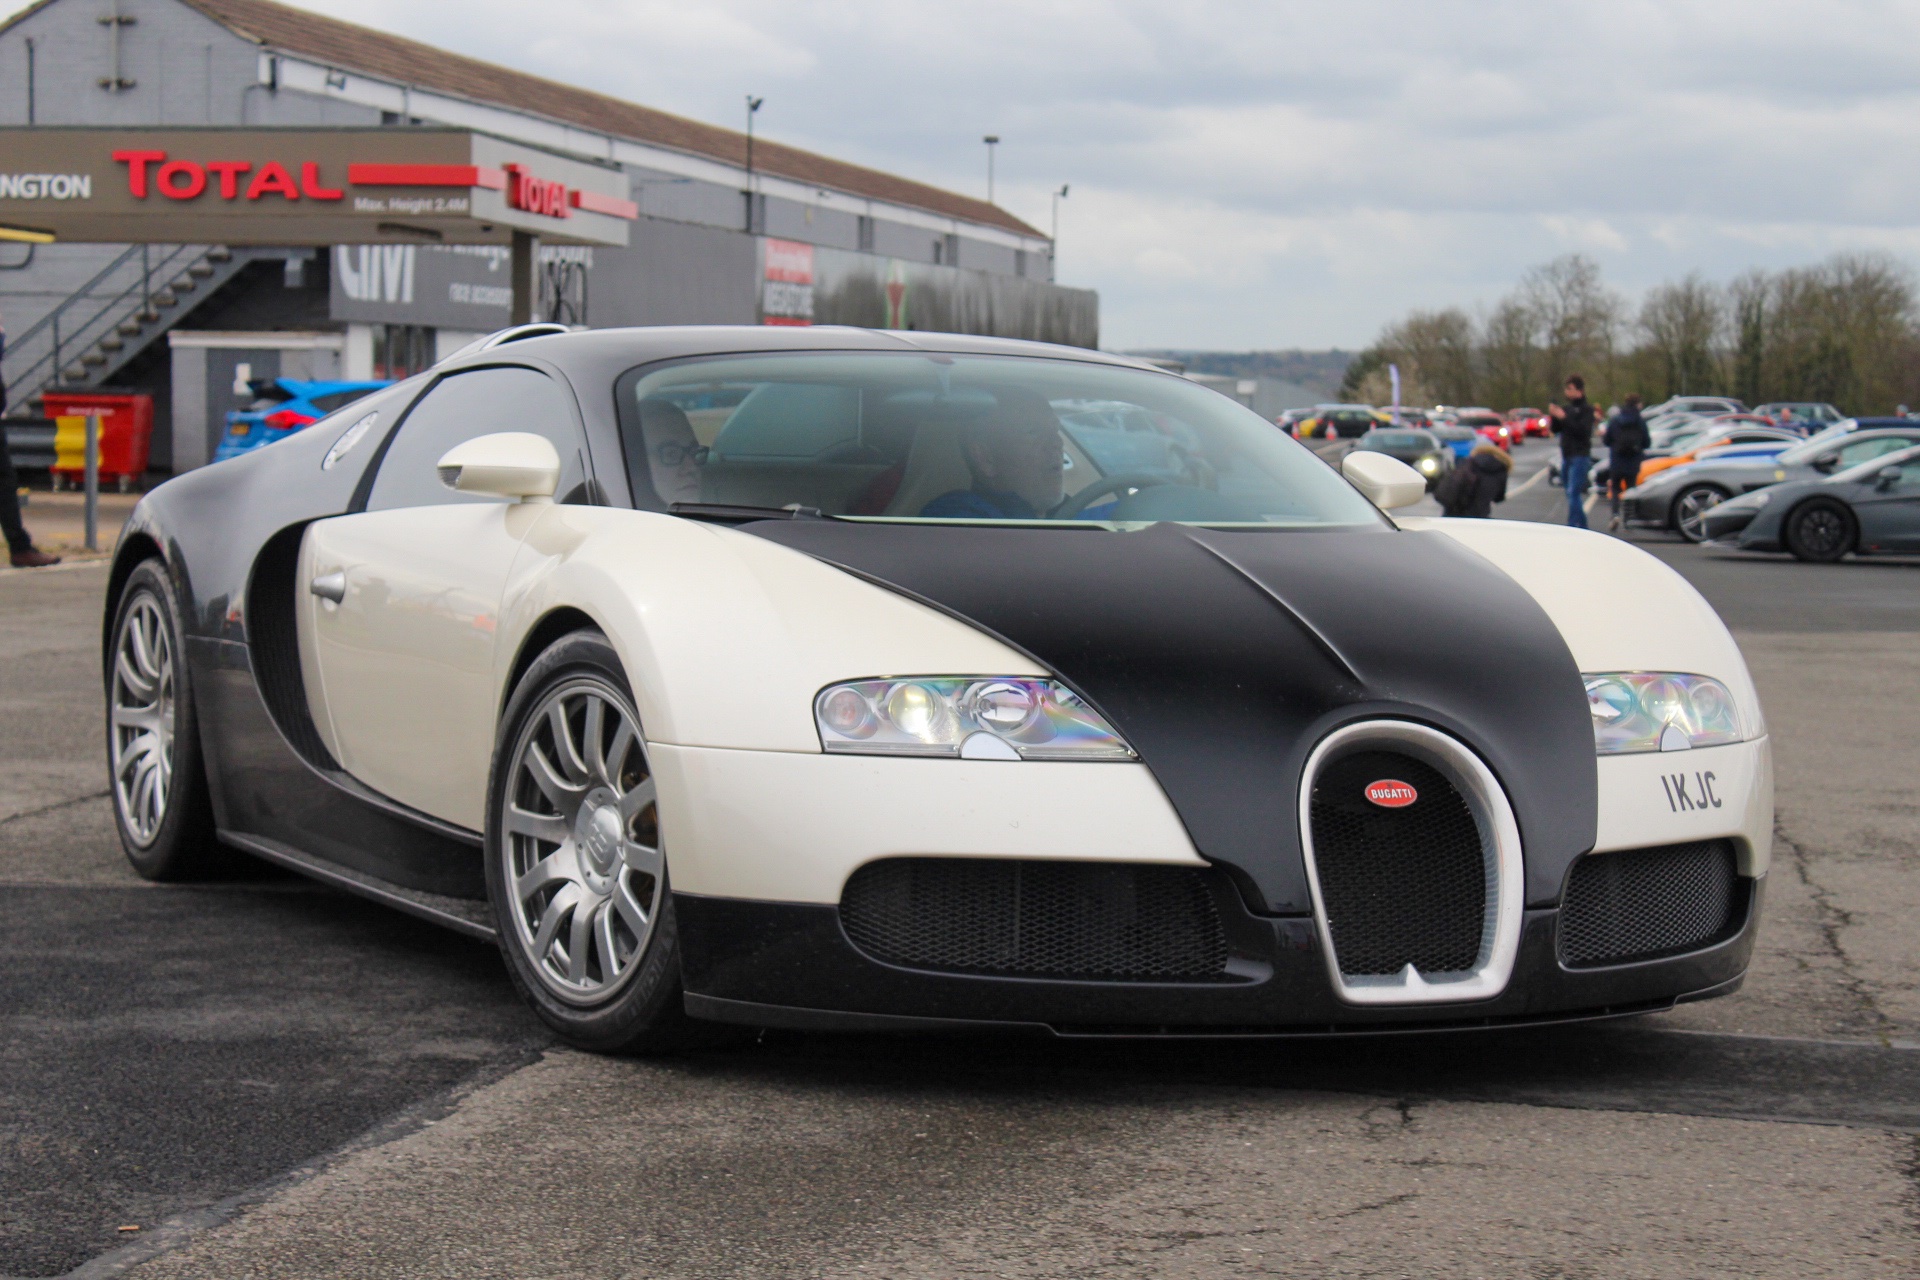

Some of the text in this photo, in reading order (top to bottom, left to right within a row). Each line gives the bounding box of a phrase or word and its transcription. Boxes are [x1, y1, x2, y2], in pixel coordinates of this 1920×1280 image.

[112, 150, 344, 200] TOTAL
[502, 162, 573, 219] TOTAL
[388, 197, 433, 215] Height
[1370, 788, 1413, 799] BUGATTI
